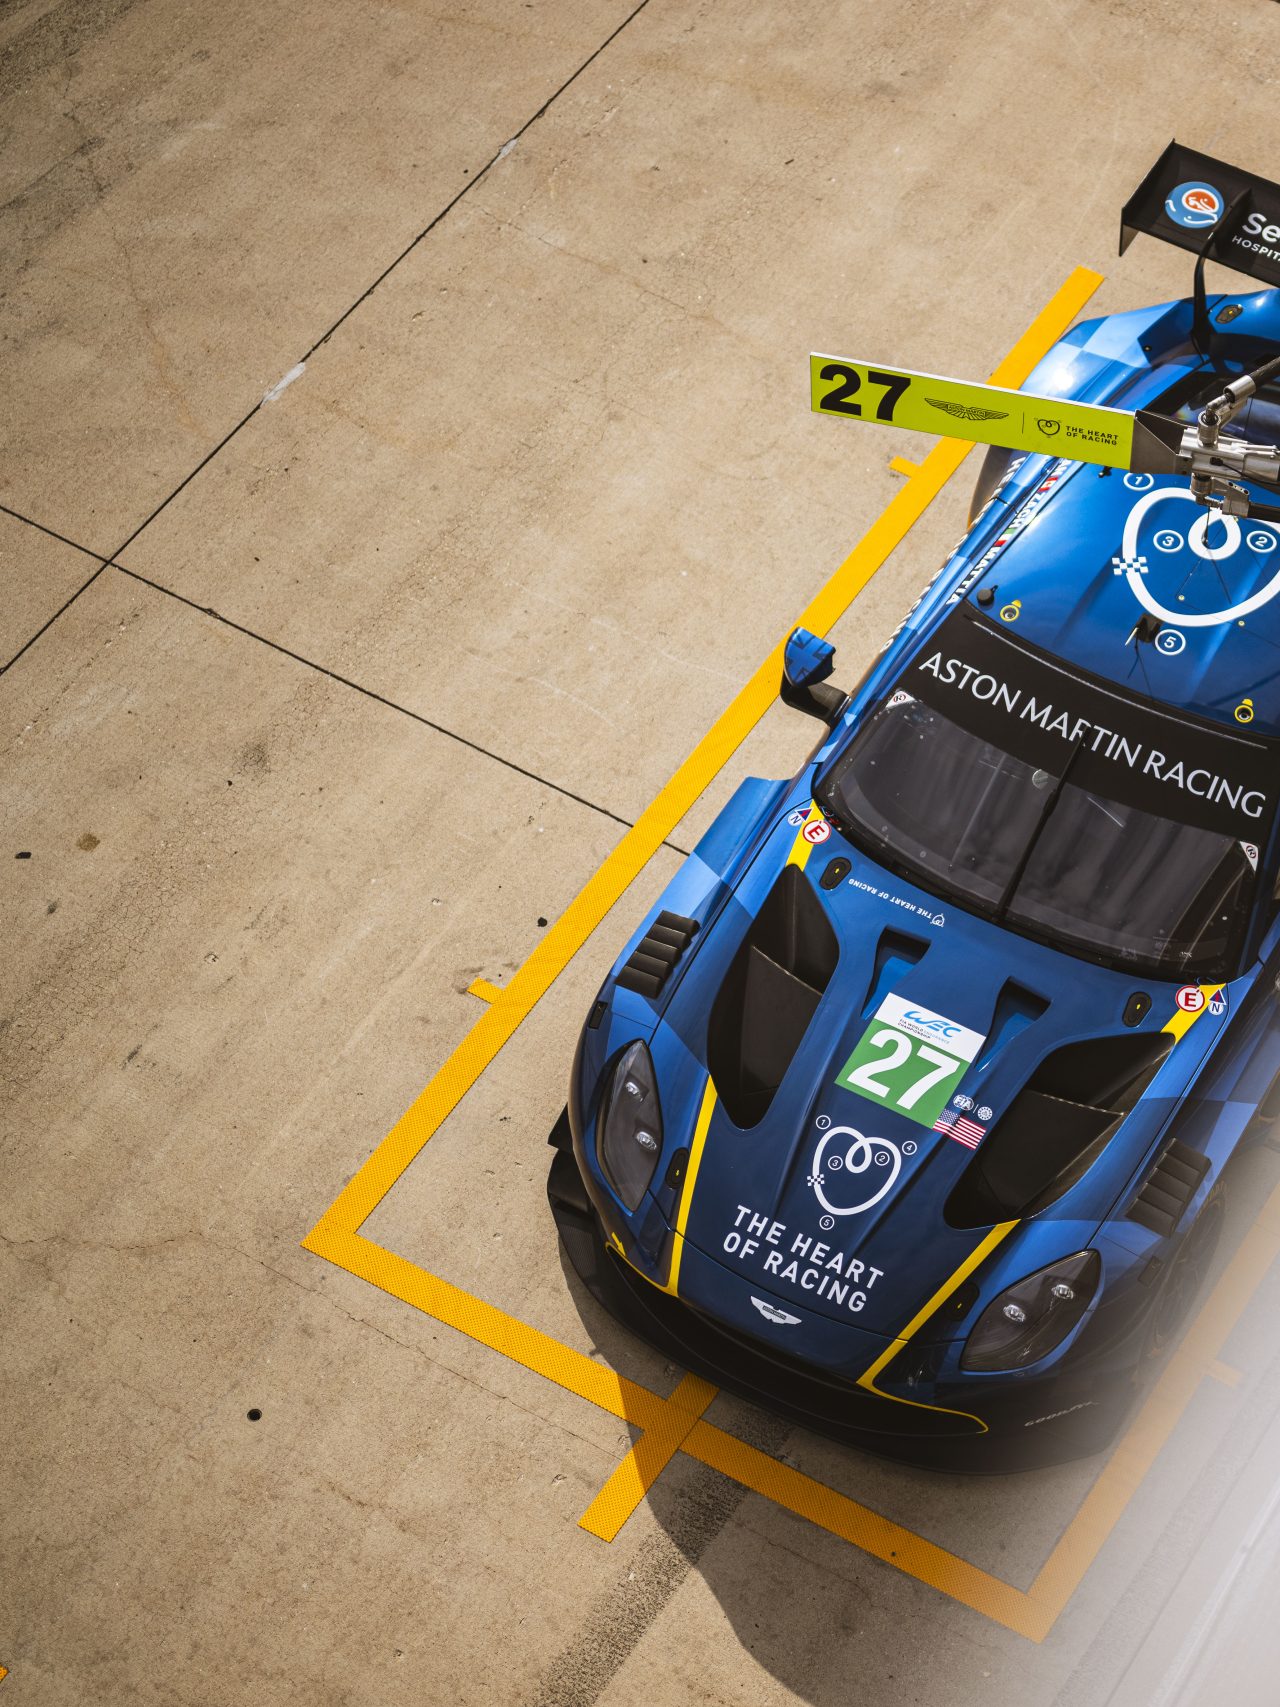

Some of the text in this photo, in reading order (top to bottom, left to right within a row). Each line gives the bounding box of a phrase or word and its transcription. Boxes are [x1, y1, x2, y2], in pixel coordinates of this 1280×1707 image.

[819, 363, 911, 421] 27
[1066, 426, 1118, 440] THE HEART
[1082, 434, 1117, 445] RACING
[946, 547, 999, 605] MATTIA
[918, 652, 1266, 818] ASTON MARTIN RACING
[848, 878, 933, 919] THE HEART OF RACING
[903, 1010, 962, 1038] WEC
[908, 1022, 924, 1032] WORLD
[846, 1029, 962, 1110] 27
[723, 1231, 867, 1313] OF RACING
[733, 1204, 884, 1290] THE HEART
